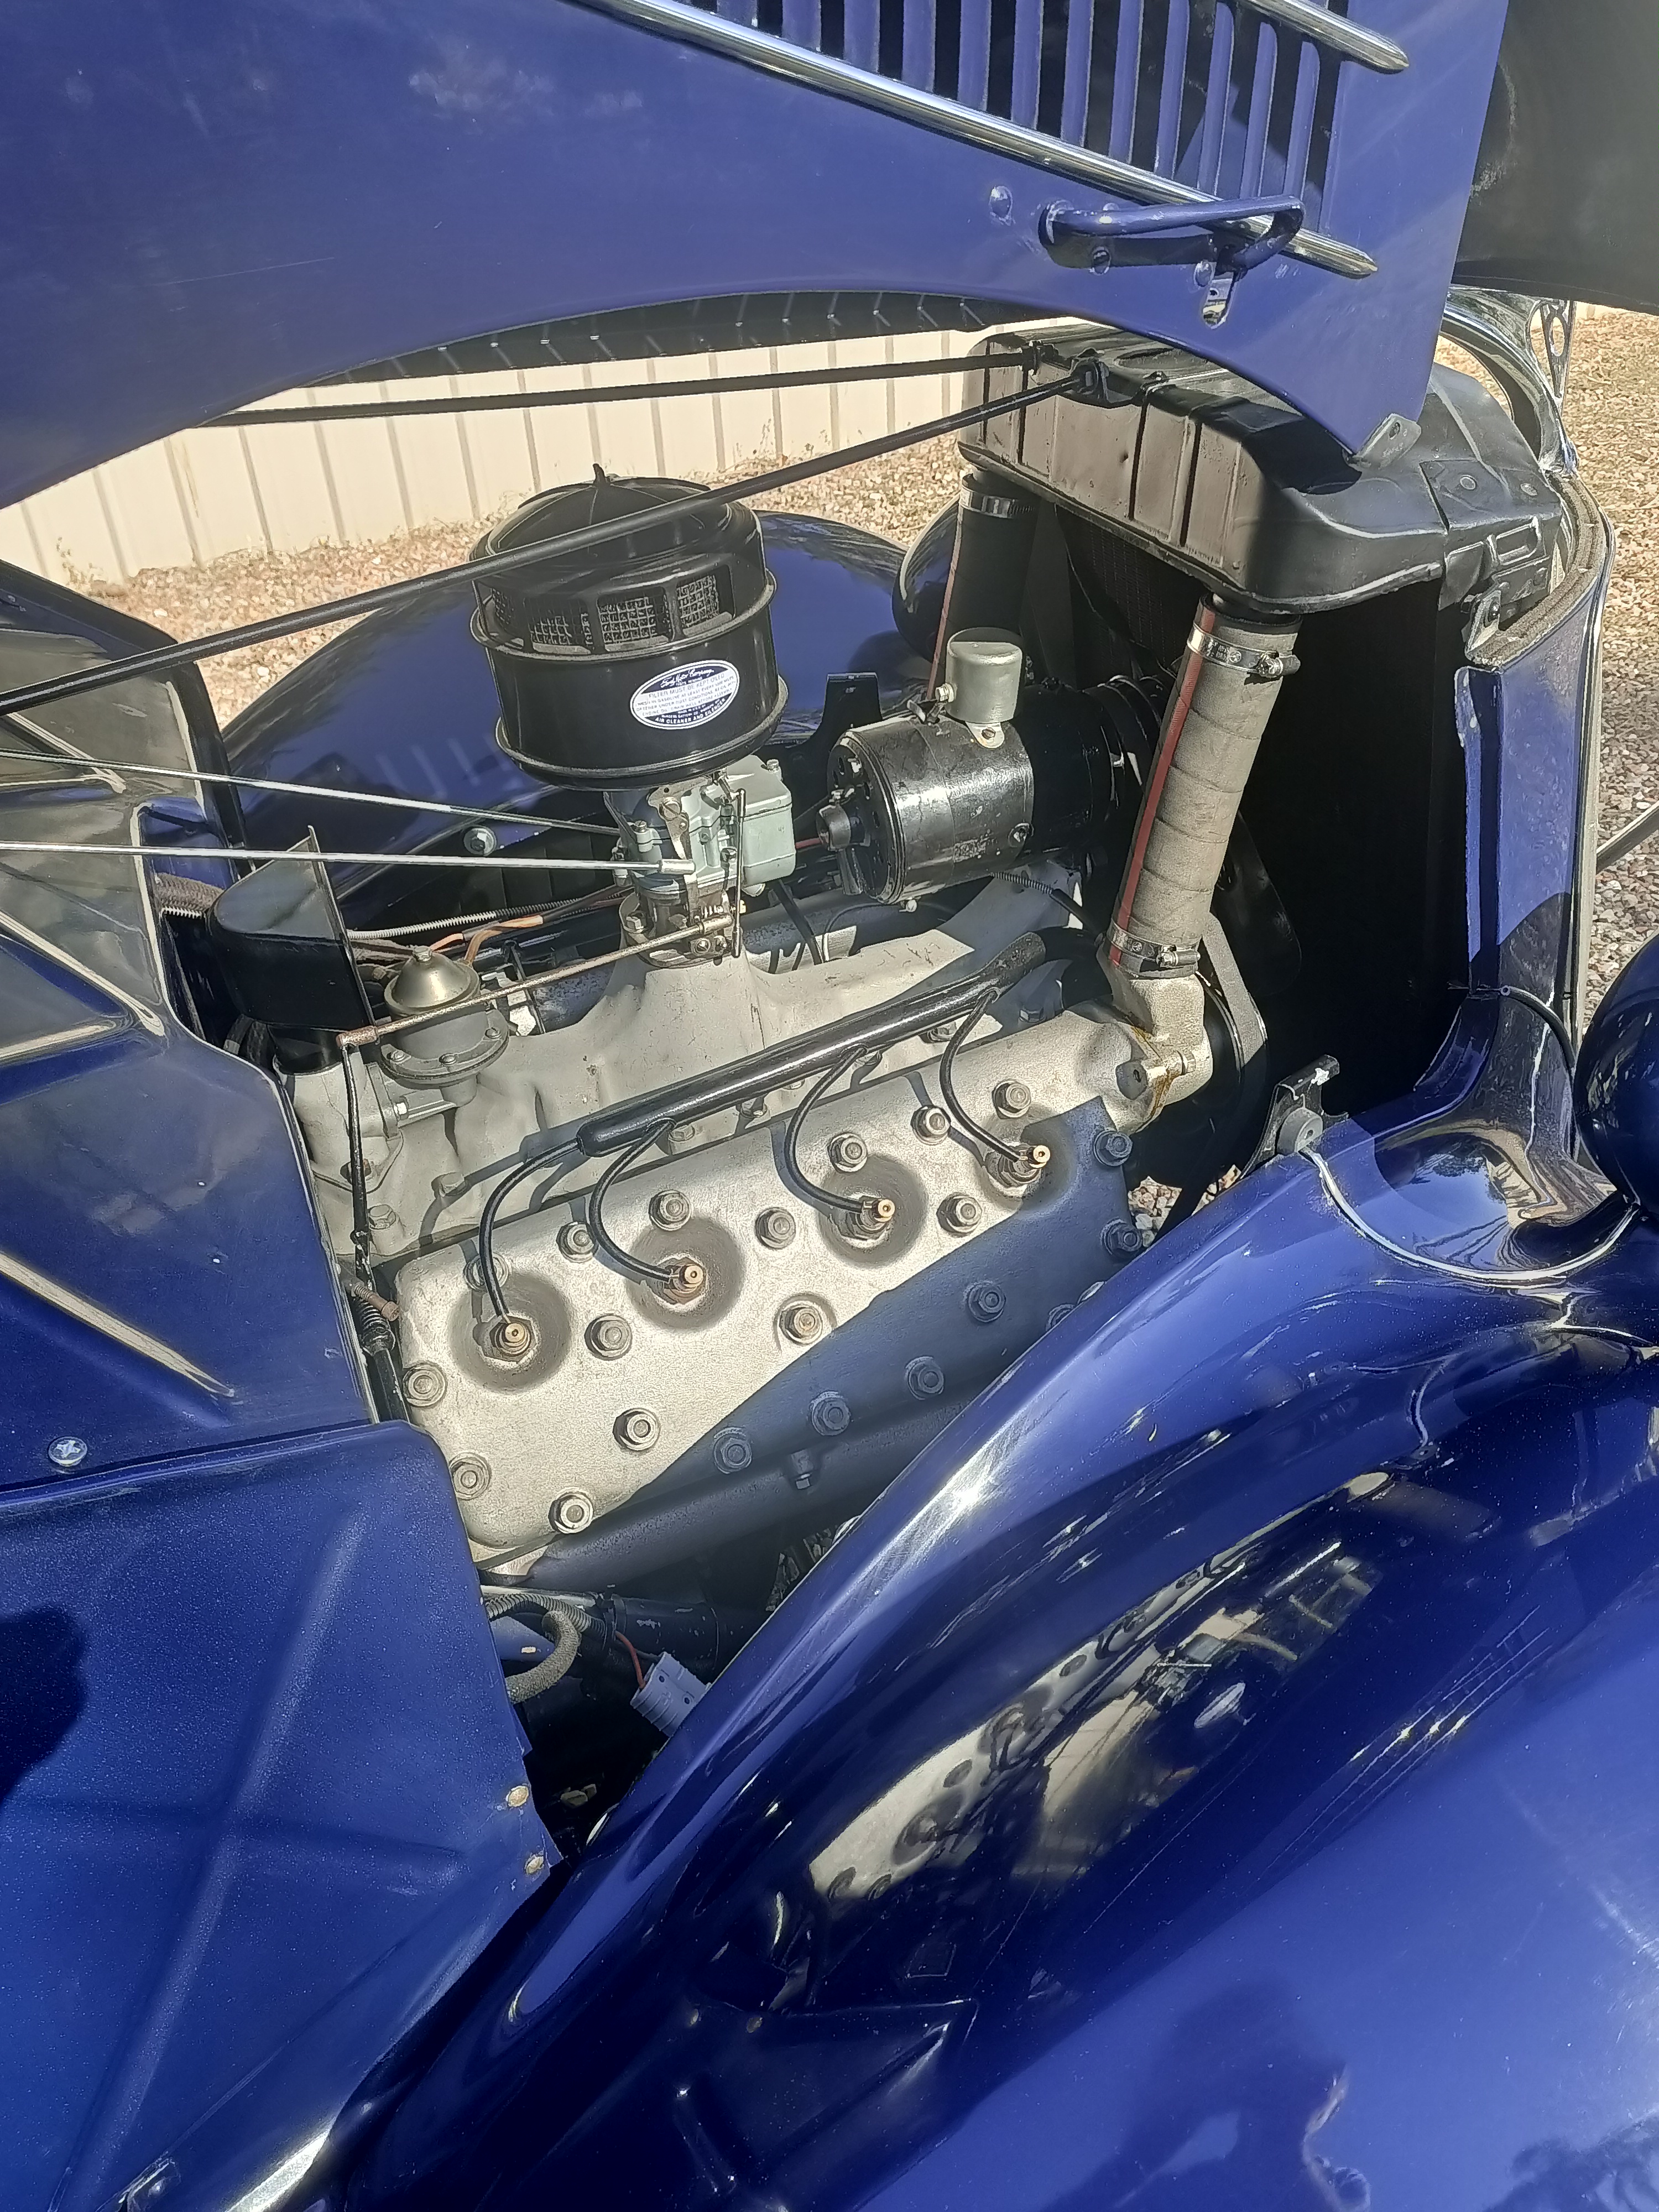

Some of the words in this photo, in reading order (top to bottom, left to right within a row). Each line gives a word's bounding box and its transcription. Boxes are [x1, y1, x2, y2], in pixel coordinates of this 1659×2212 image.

[670, 686, 685, 695] MUST
[696, 679, 709, 688] KEPT
[705, 697, 726, 717] SILENCER
